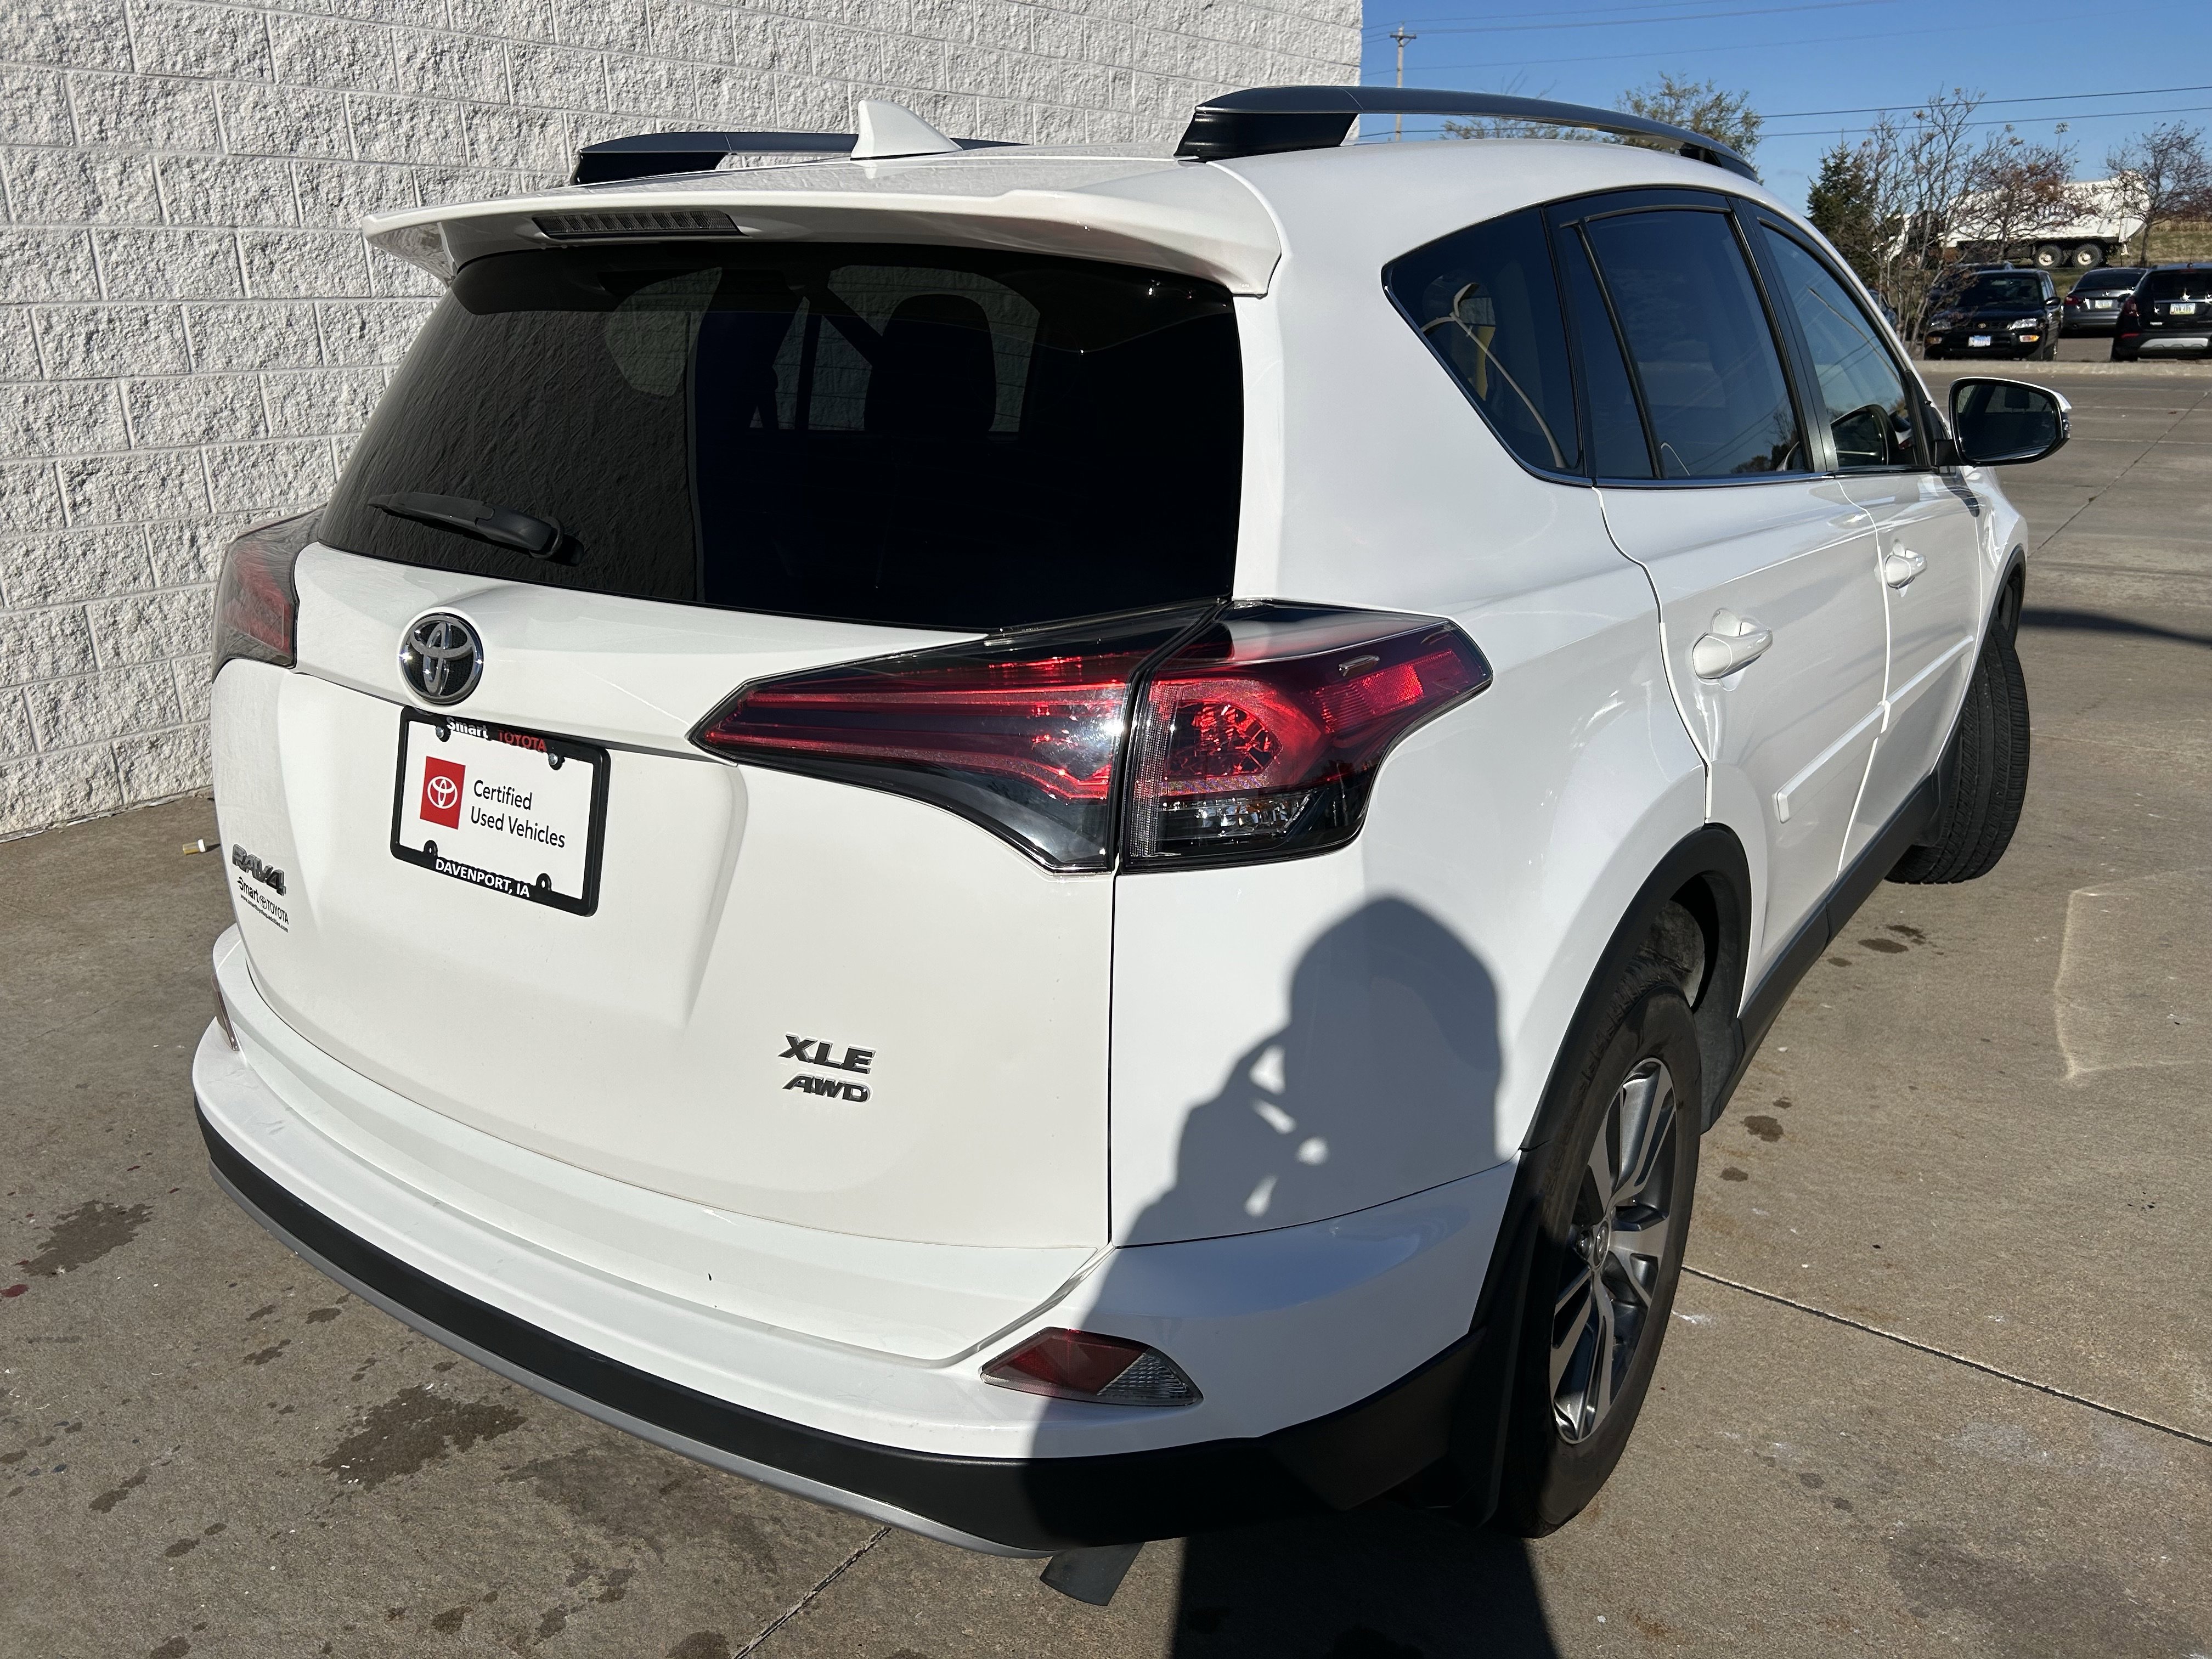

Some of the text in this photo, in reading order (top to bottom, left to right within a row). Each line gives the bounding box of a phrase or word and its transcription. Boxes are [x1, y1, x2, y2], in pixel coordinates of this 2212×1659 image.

[446, 716, 548, 752] Smart TOYOTA
[473, 780, 533, 810] Certified
[471, 806, 565, 848] Used Vehicles
[232, 844, 287, 896] RAV4
[435, 858, 531, 898] DAVENPORT, IA
[237, 876, 259, 903] Smart
[266, 899, 289, 925] TOYOTA
[778, 1033, 876, 1075] XLE
[782, 1073, 872, 1103] AWD
